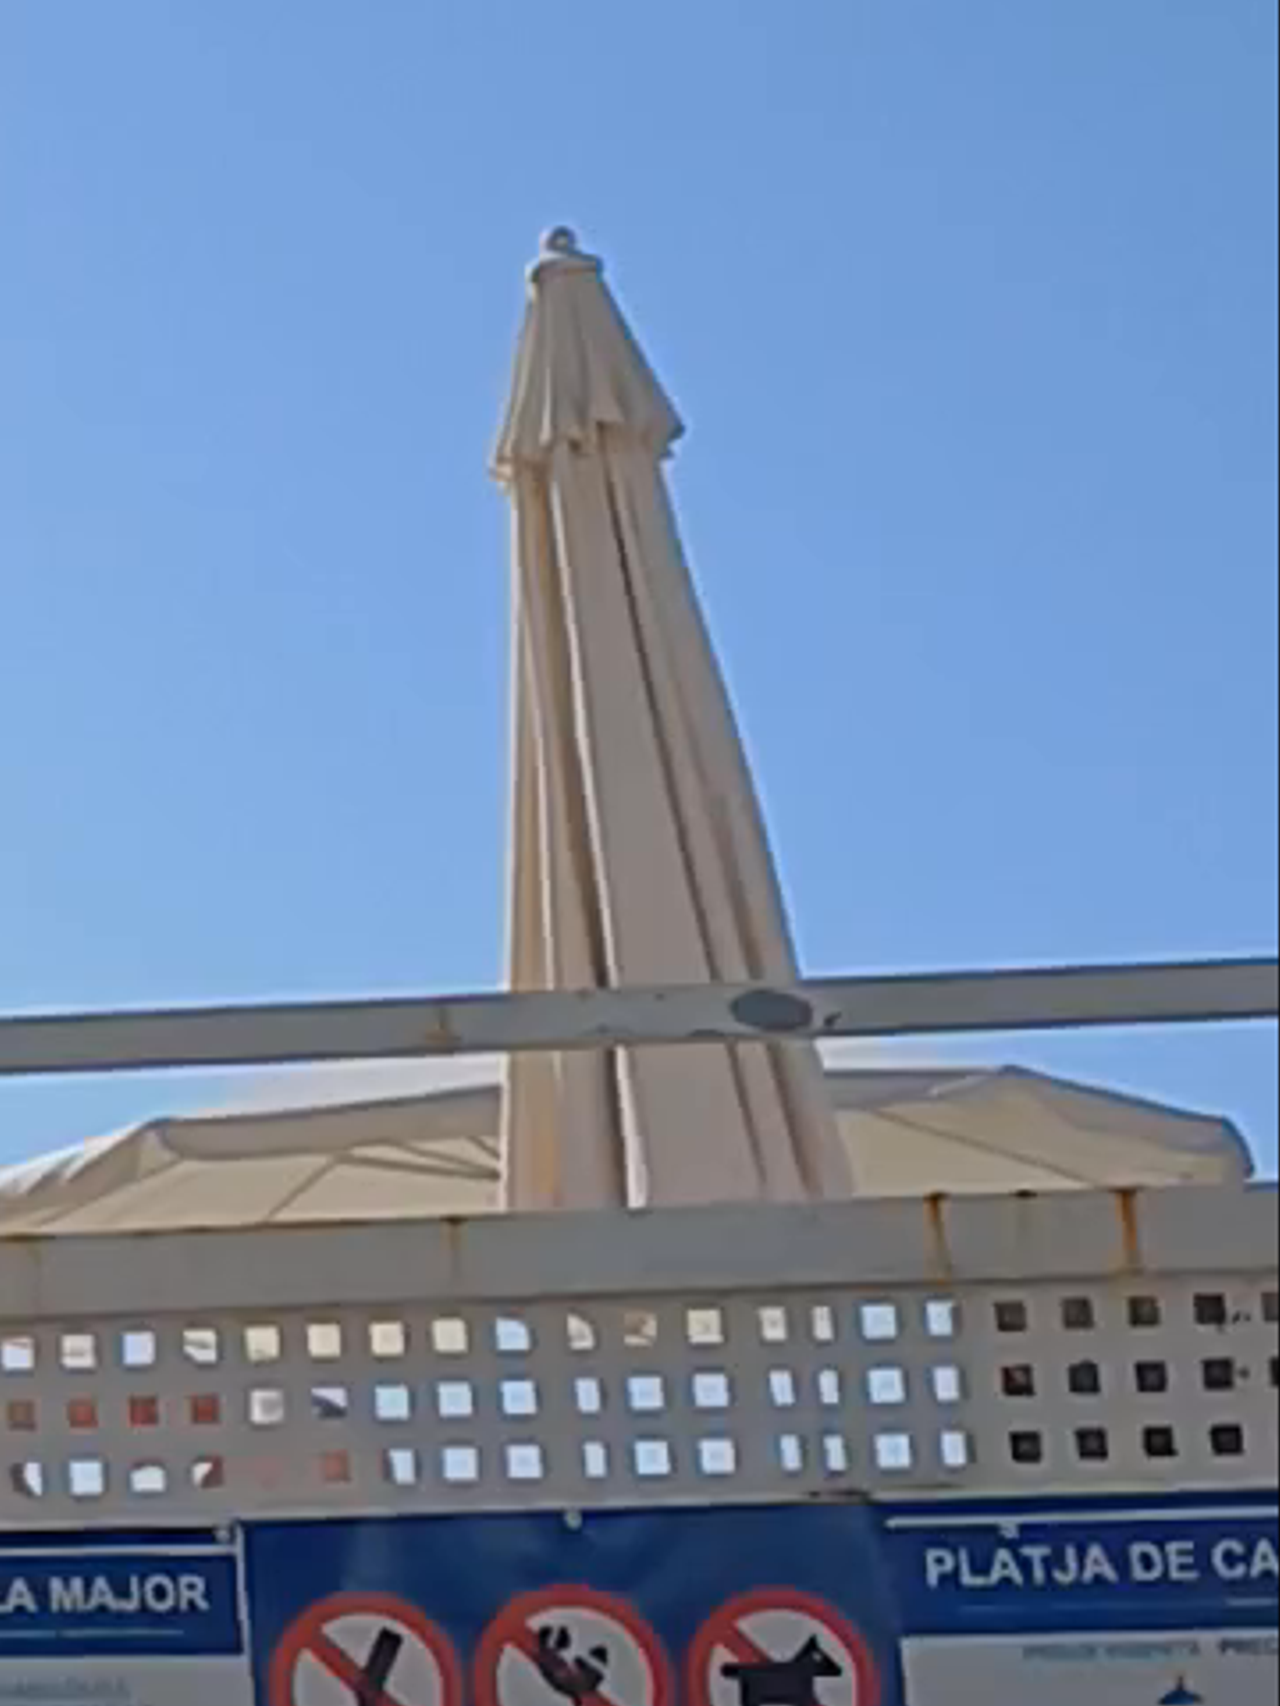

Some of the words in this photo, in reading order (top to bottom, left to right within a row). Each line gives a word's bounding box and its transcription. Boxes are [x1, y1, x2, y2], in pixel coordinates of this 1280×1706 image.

[924, 1545, 1118, 1589] PLATJA
[1128, 1543, 1200, 1583] DE
[49, 1573, 210, 1613] MAJOR
